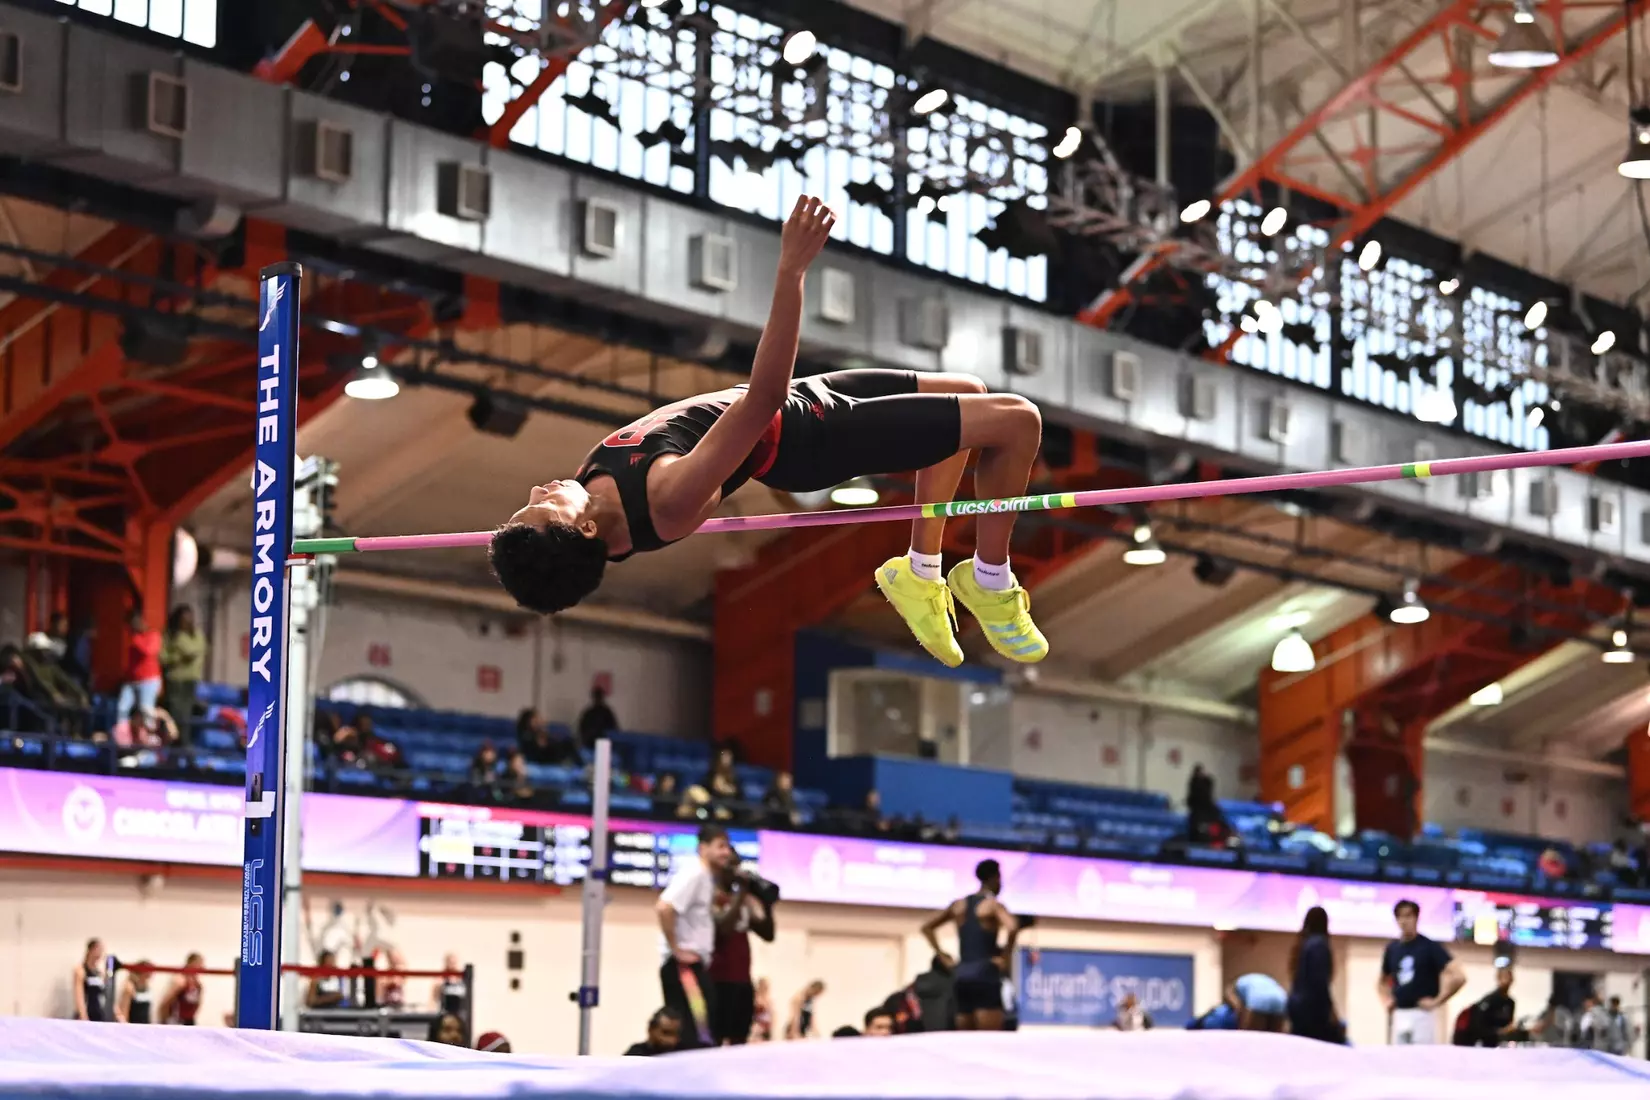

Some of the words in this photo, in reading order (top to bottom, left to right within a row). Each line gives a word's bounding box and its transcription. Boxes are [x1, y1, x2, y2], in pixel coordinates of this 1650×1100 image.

[260, 344, 279, 445] THE
[252, 460, 276, 682] ARMORY
[249, 859, 264, 966] UCS
